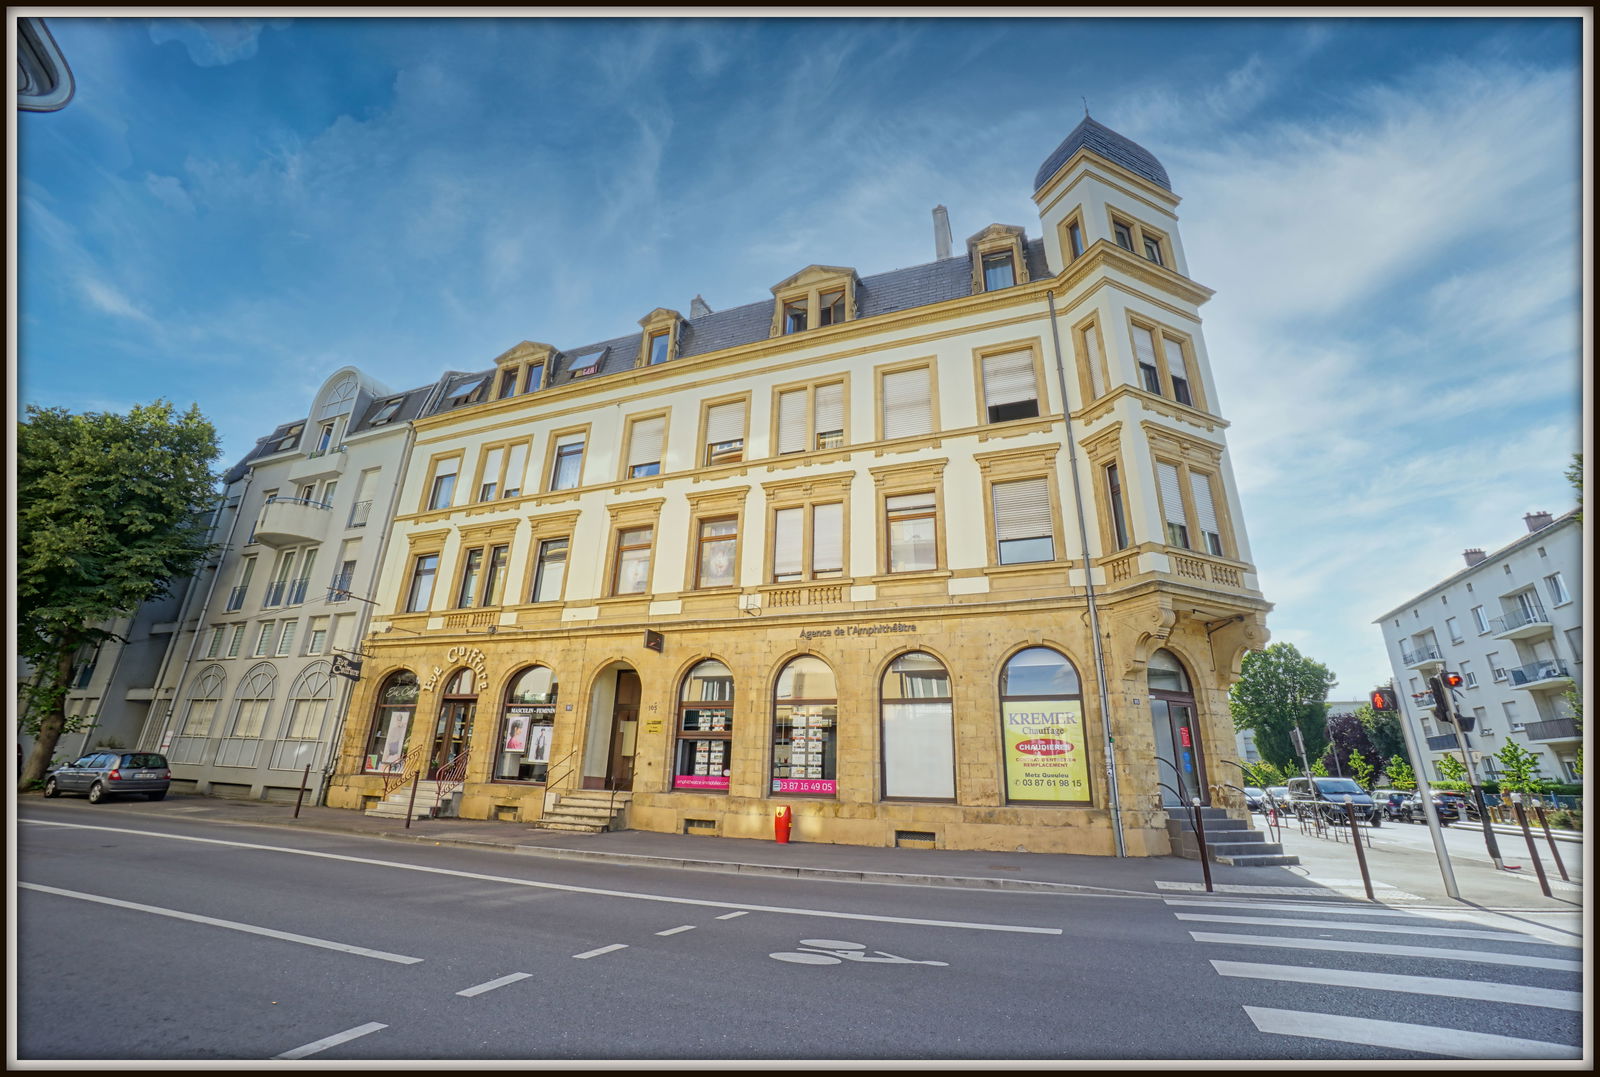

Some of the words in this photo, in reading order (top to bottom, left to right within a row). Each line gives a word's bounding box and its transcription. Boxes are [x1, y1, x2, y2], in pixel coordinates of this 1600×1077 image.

[800, 629, 832, 640] Agence
[834, 627, 845, 637] de
[423, 666, 443, 692] Eve
[1009, 712, 1078, 725] KREMER
[1023, 727, 1064, 736] Chauffage
[789, 781, 799, 790] 87
[800, 782, 809, 790] 16
[811, 782, 821, 791] 49
[822, 782, 833, 791] 05
[1046, 779, 1057, 787] 61
[1059, 779, 1070, 787] 98
[1072, 780, 1082, 788] 15
